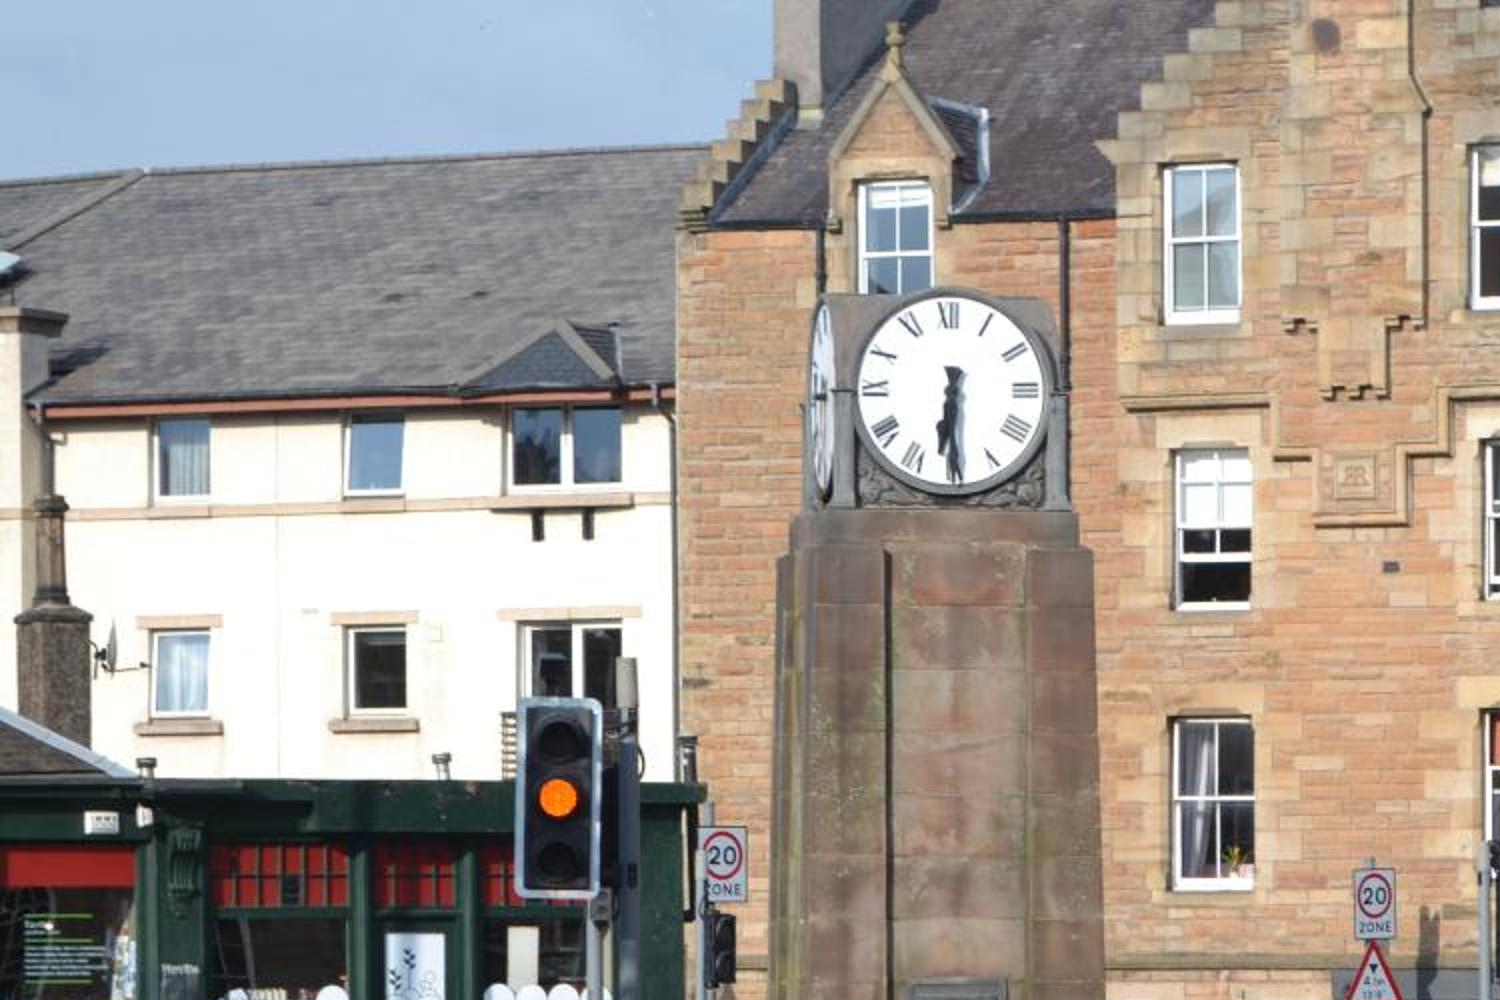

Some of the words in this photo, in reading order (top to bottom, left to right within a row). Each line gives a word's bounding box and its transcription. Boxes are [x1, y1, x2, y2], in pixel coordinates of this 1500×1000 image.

[937, 302, 960, 329] XII
[1001, 341, 1029, 363] II
[862, 379, 889, 397] IX
[1012, 382, 1039, 399] III
[709, 845, 737, 865] 20
[1363, 887, 1387, 905] 20
[1359, 921, 1392, 934] ZONE
